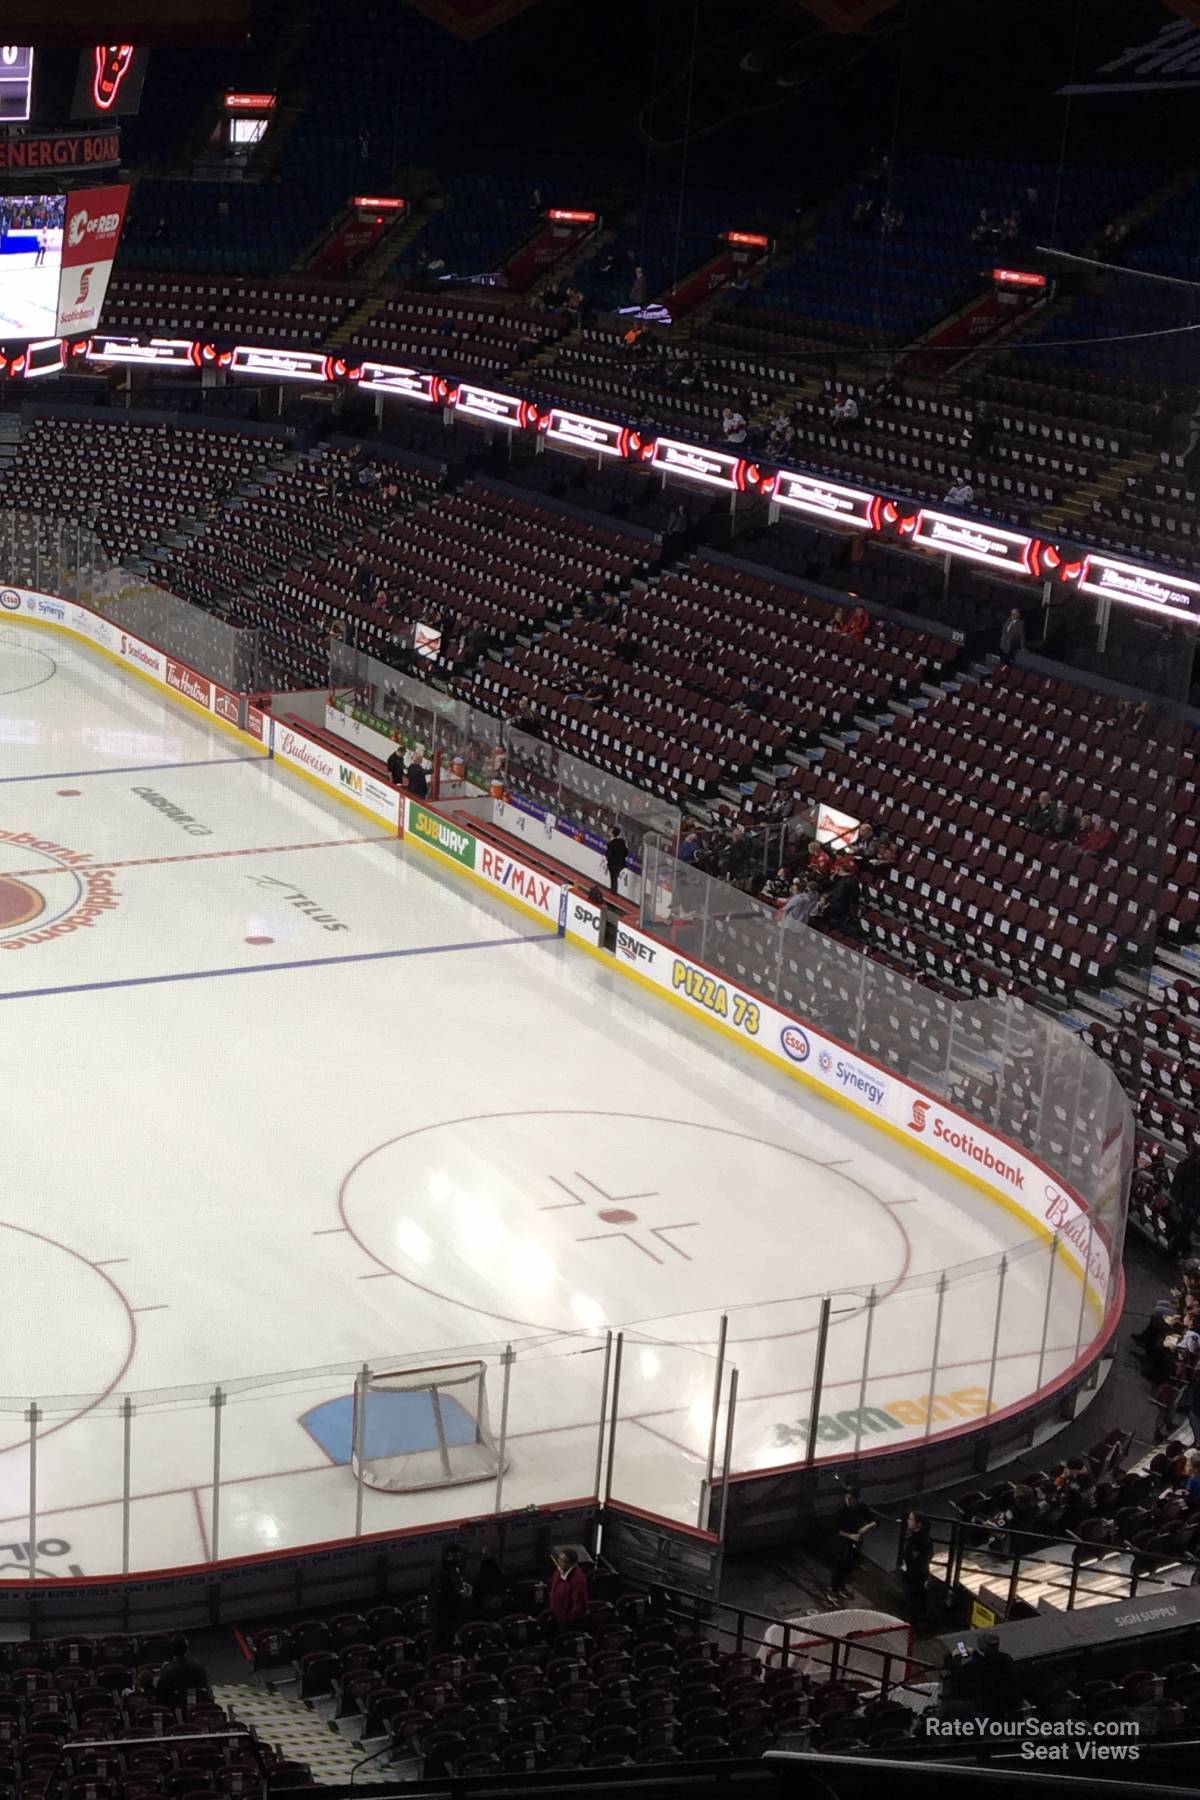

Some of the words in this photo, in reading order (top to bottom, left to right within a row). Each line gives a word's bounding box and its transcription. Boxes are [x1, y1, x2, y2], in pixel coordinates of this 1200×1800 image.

[87, 219, 98, 233] OF
[97, 213, 120, 234] RED
[37, 600, 66, 621] Synergy
[166, 661, 182, 688] Tim
[181, 670, 209, 706] Hortons
[280, 728, 334, 777] Budweiser
[415, 811, 470, 857] SUBWAY
[481, 857, 552, 912] RE/MAX
[0, 869, 124, 952] Saddledome
[284, 891, 351, 934] TELUS
[672, 957, 729, 1018] PIZZA
[732, 993, 761, 1036] 73
[783, 1035, 807, 1055] Esso
[835, 1061, 885, 1106] Synergy
[932, 1117, 1025, 1191] Scotiabank
[774, 1386, 1000, 1443] SUBWAY
[1142, 1604, 1178, 1622] SUPPLY
